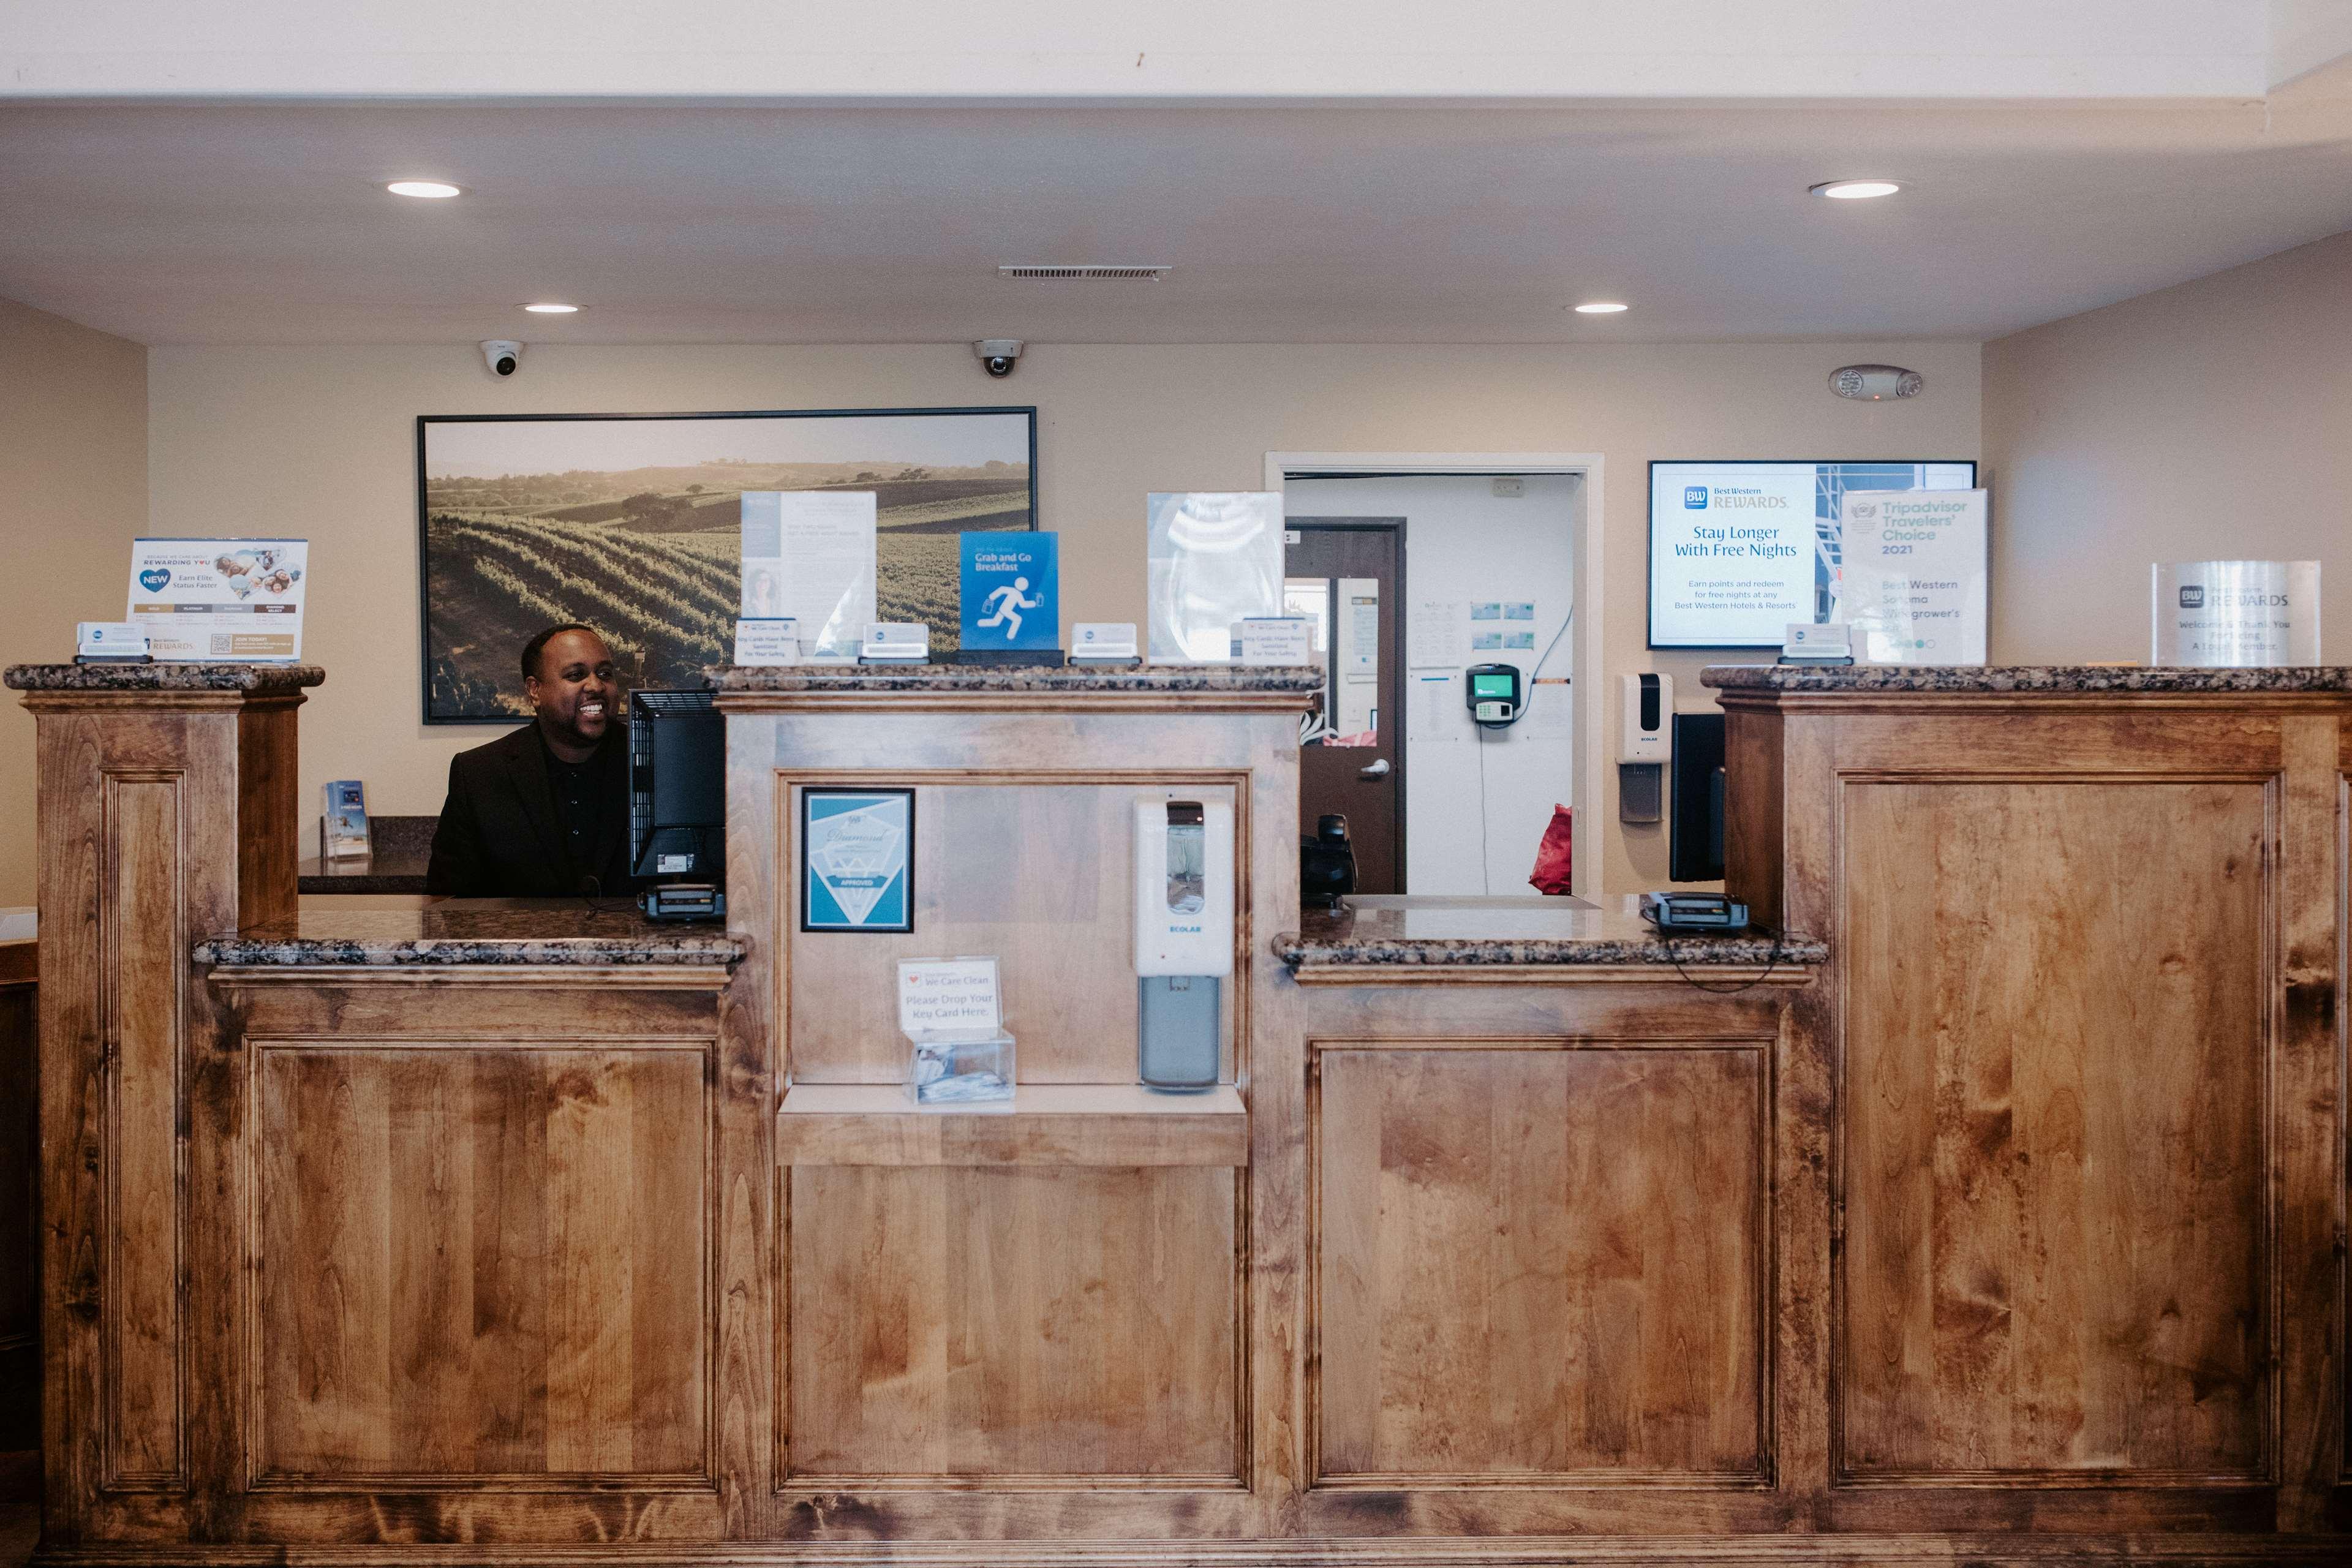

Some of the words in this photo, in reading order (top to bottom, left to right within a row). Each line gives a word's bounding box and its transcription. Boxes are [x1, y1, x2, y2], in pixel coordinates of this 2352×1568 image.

[1687, 491, 1706, 502] BW
[1882, 500, 1968, 516] Tripadvisor
[1693, 526, 1725, 541] Stay
[1730, 526, 1780, 541] Longer
[1882, 529, 1936, 541] Choice
[1675, 543, 1709, 557] With
[1713, 543, 1745, 557] Free
[1750, 543, 1797, 560] Nights
[1882, 545, 1913, 554] 2021
[974, 552, 997, 562] Grab
[999, 552, 1017, 562] and
[1018, 552, 1032, 563] Go
[975, 562, 1019, 571] Breakfast
[143, 575, 168, 584] NEW
[1708, 580, 1734, 590] points
[1909, 580, 1959, 589] Western
[1725, 591, 1751, 600] nights
[1882, 594, 1929, 604] Soma
[2182, 590, 2203, 601] BW
[925, 978, 939, 986] We
[941, 977, 961, 986] Care
[963, 976, 989, 985] Clean
[907, 995, 938, 1005] Please
[941, 994, 967, 1005] Drop
[970, 993, 993, 1003] Your
[913, 1009, 932, 1019] Key
[935, 1008, 959, 1017] Card
